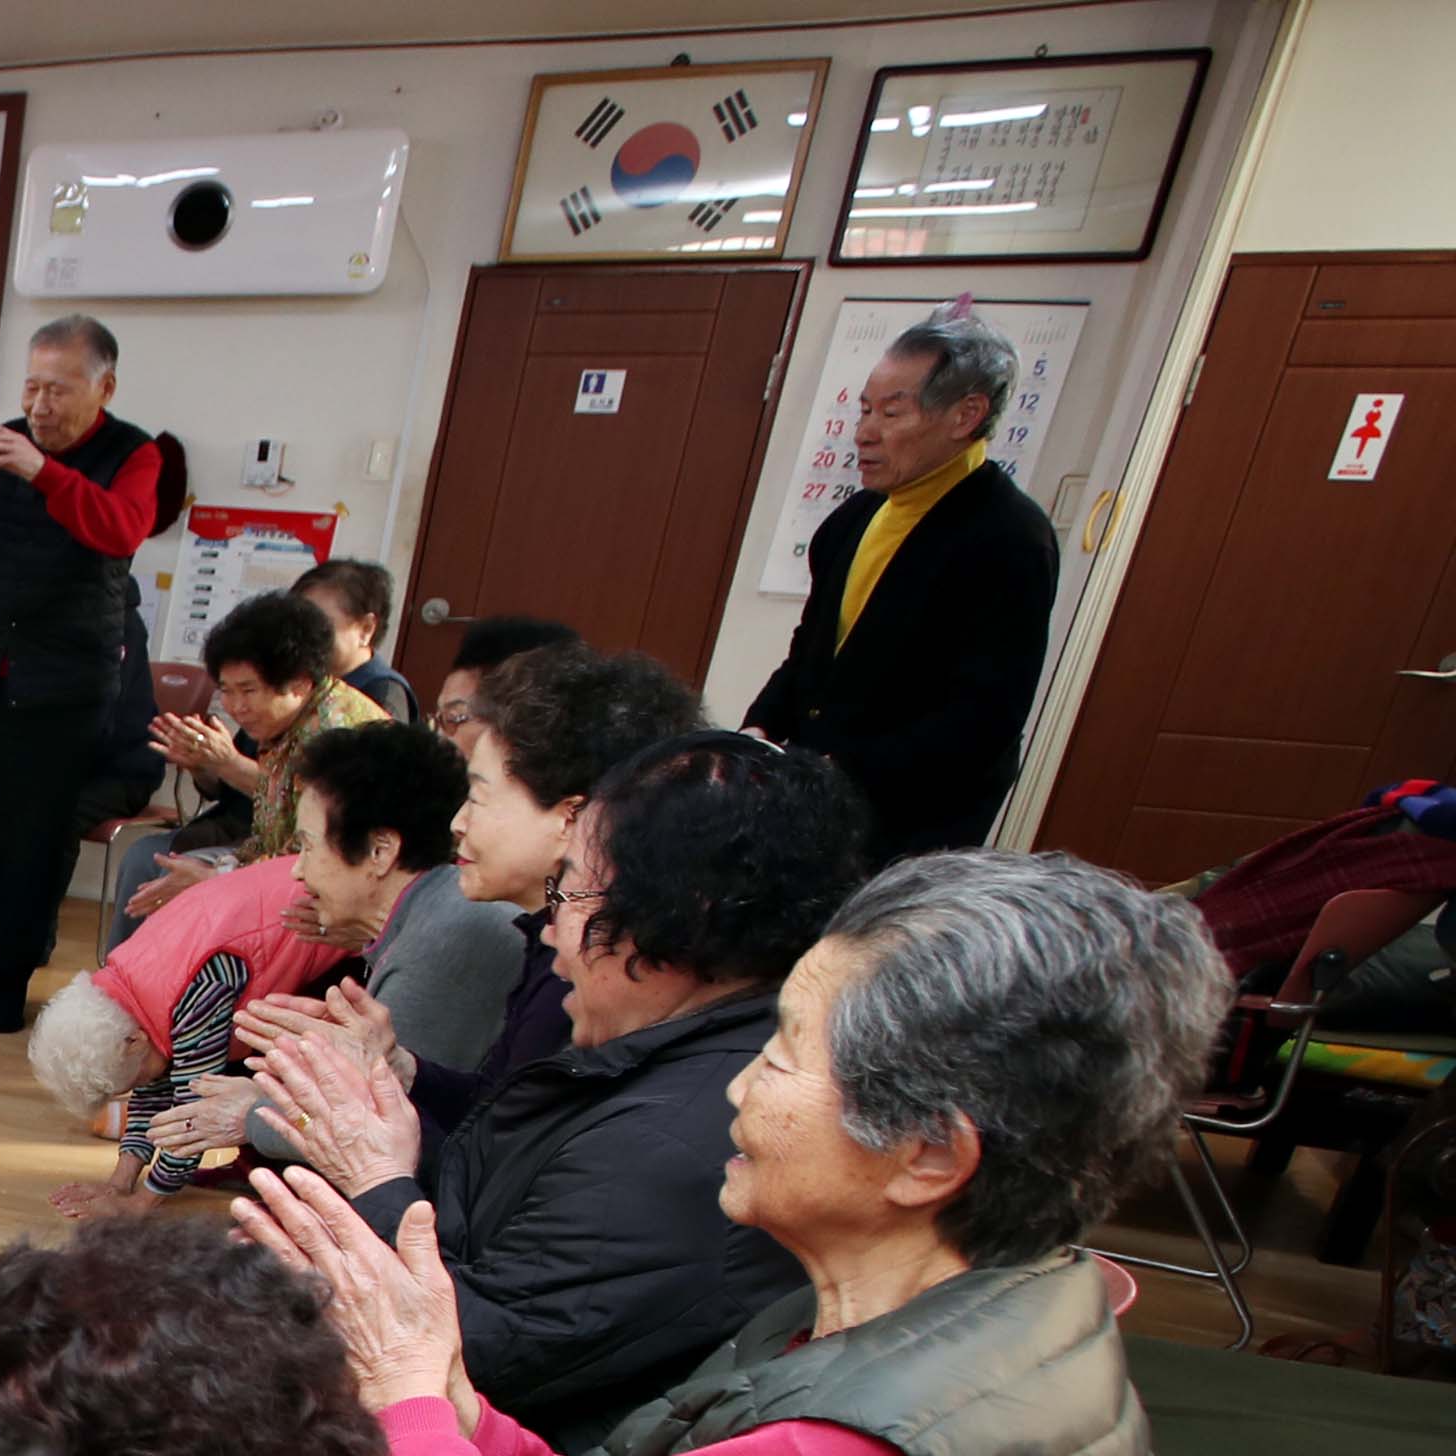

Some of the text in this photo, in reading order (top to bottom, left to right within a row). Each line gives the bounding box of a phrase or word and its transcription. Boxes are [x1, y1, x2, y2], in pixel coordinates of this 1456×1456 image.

[1032, 359, 1047, 376] 5
[837, 387, 848, 403] 6
[1018, 393, 1040, 410] 12
[825, 419, 844, 437] 13
[1008, 425, 1029, 442] 19
[813, 451, 836, 468] 20
[802, 482, 827, 500] 27
